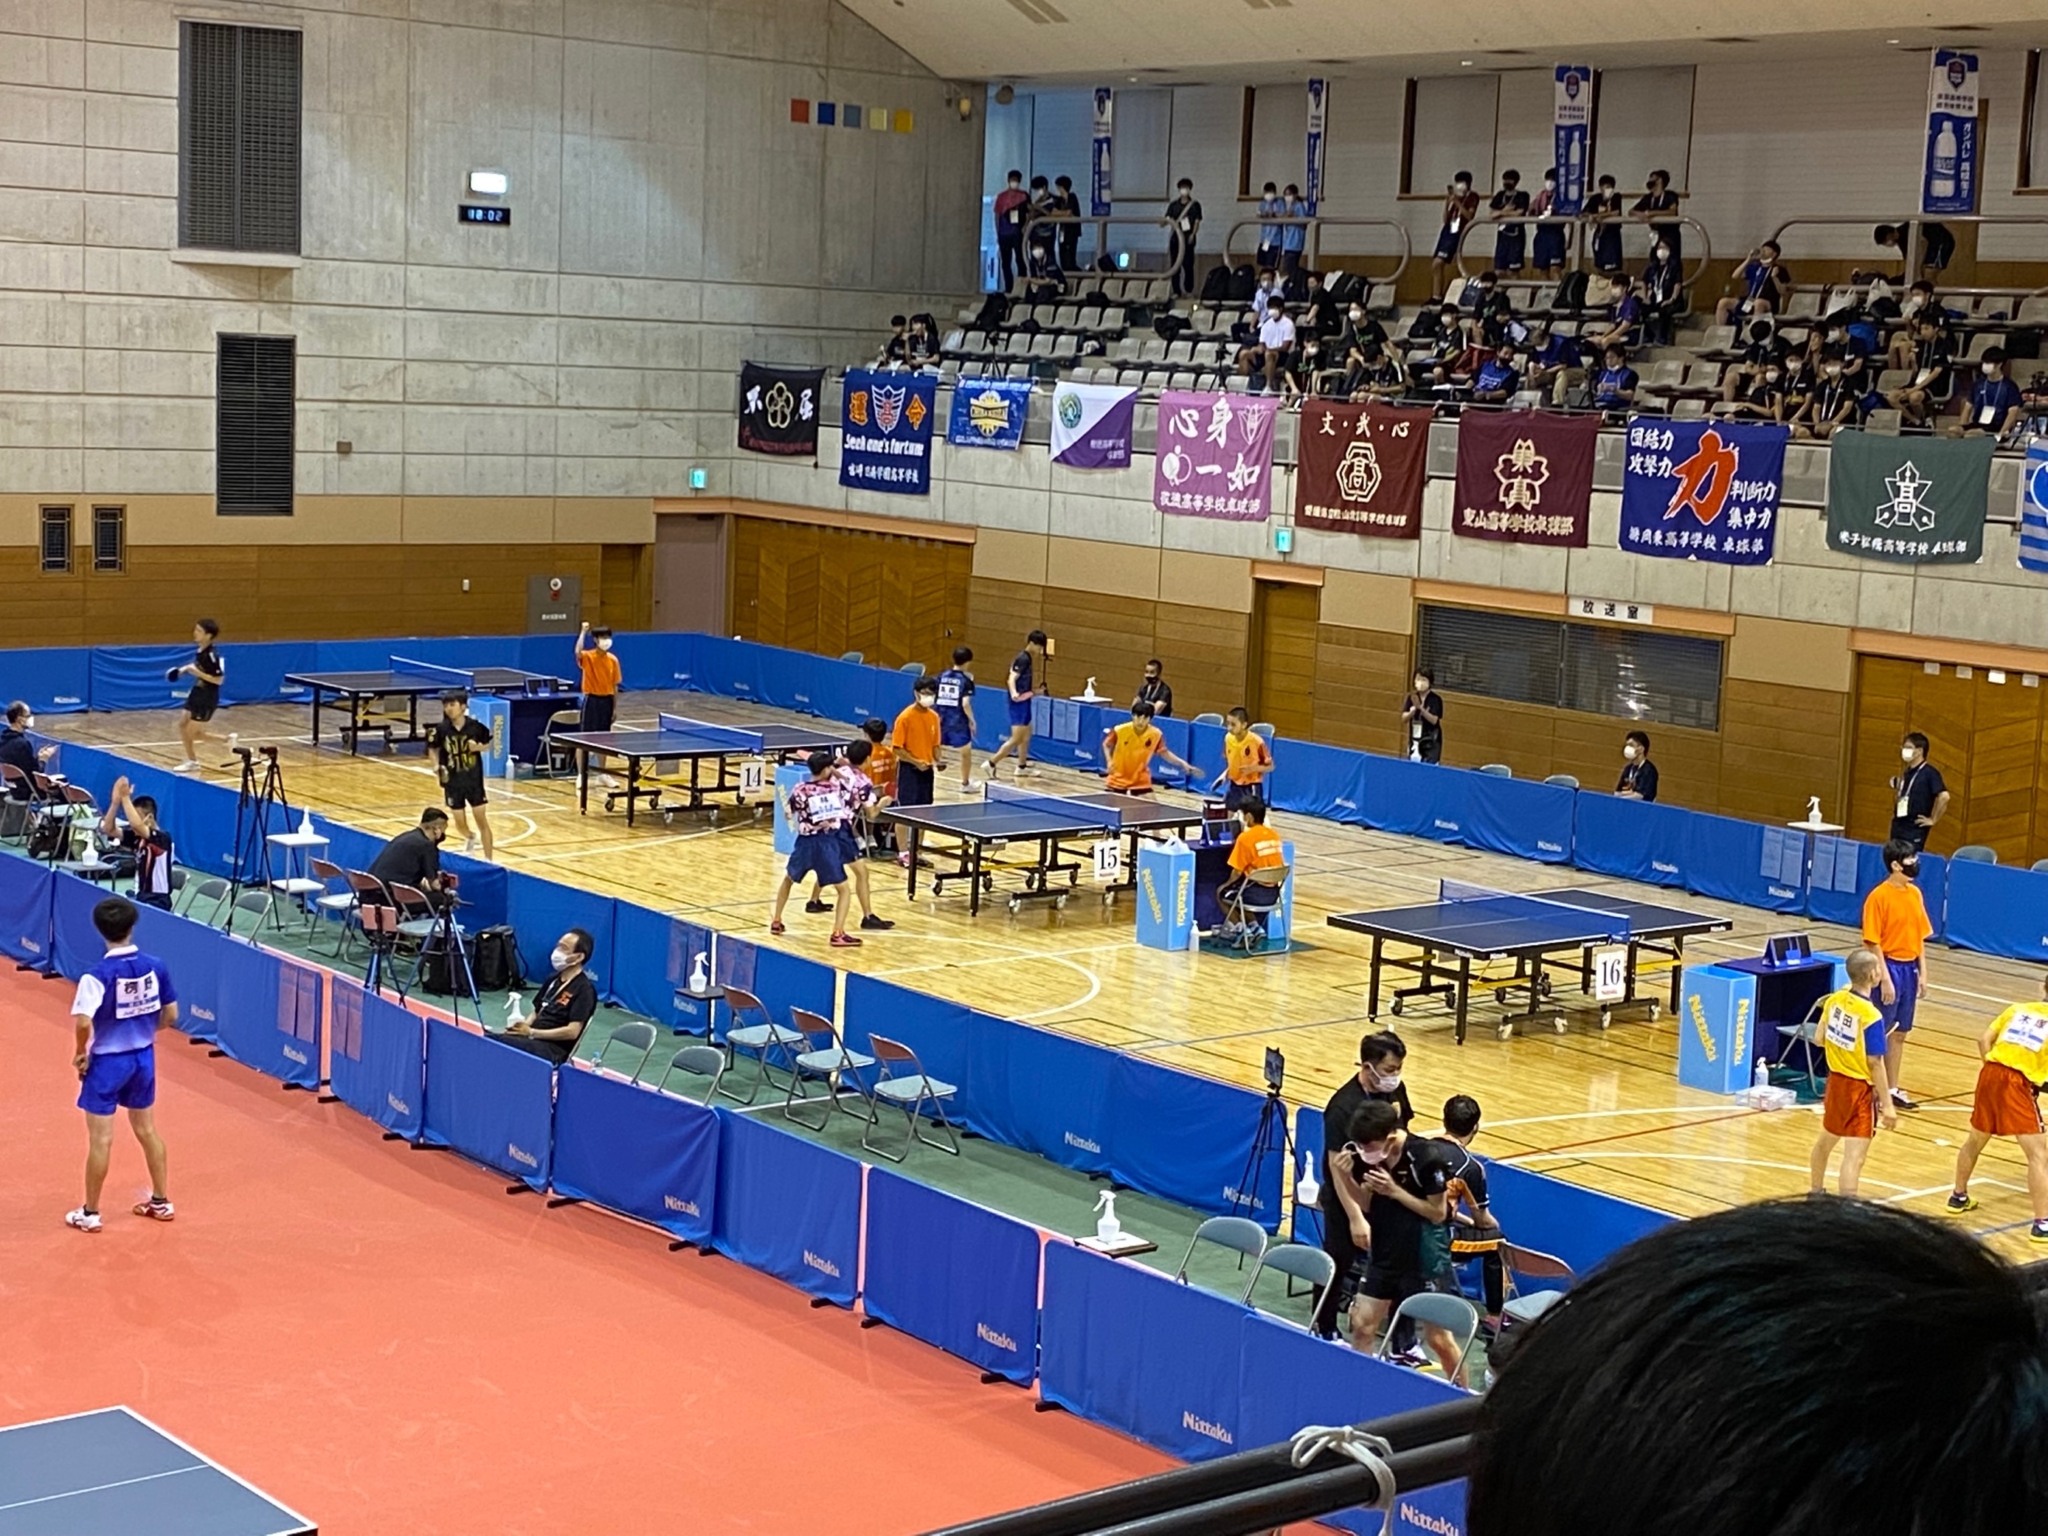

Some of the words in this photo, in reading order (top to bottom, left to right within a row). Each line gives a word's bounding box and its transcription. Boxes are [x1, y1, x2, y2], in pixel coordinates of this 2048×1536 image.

[1630, 427, 1675, 452] 団結力
[1628, 452, 1673, 478] 攻撃力
[1663, 428, 1740, 526] 力
[1730, 479, 1777, 503] 判断力
[1727, 506, 1772, 530] 集中力
[1582, 600, 1639, 620] 放送室
[745, 767, 762, 787] 14
[1099, 846, 1118, 871] 15
[1177, 870, 1191, 928] Nittaku
[1602, 959, 1621, 987] 16
[1688, 994, 1719, 1063] Nittaku
[1733, 998, 1750, 1067] Nittaku
[1065, 1131, 1101, 1154] Nittaku
[803, 1249, 841, 1278] Nittaku
[976, 1322, 1018, 1353] Nittaku
[1183, 1410, 1233, 1446] Nittaku
[1399, 1501, 1460, 1536] Nittaku
